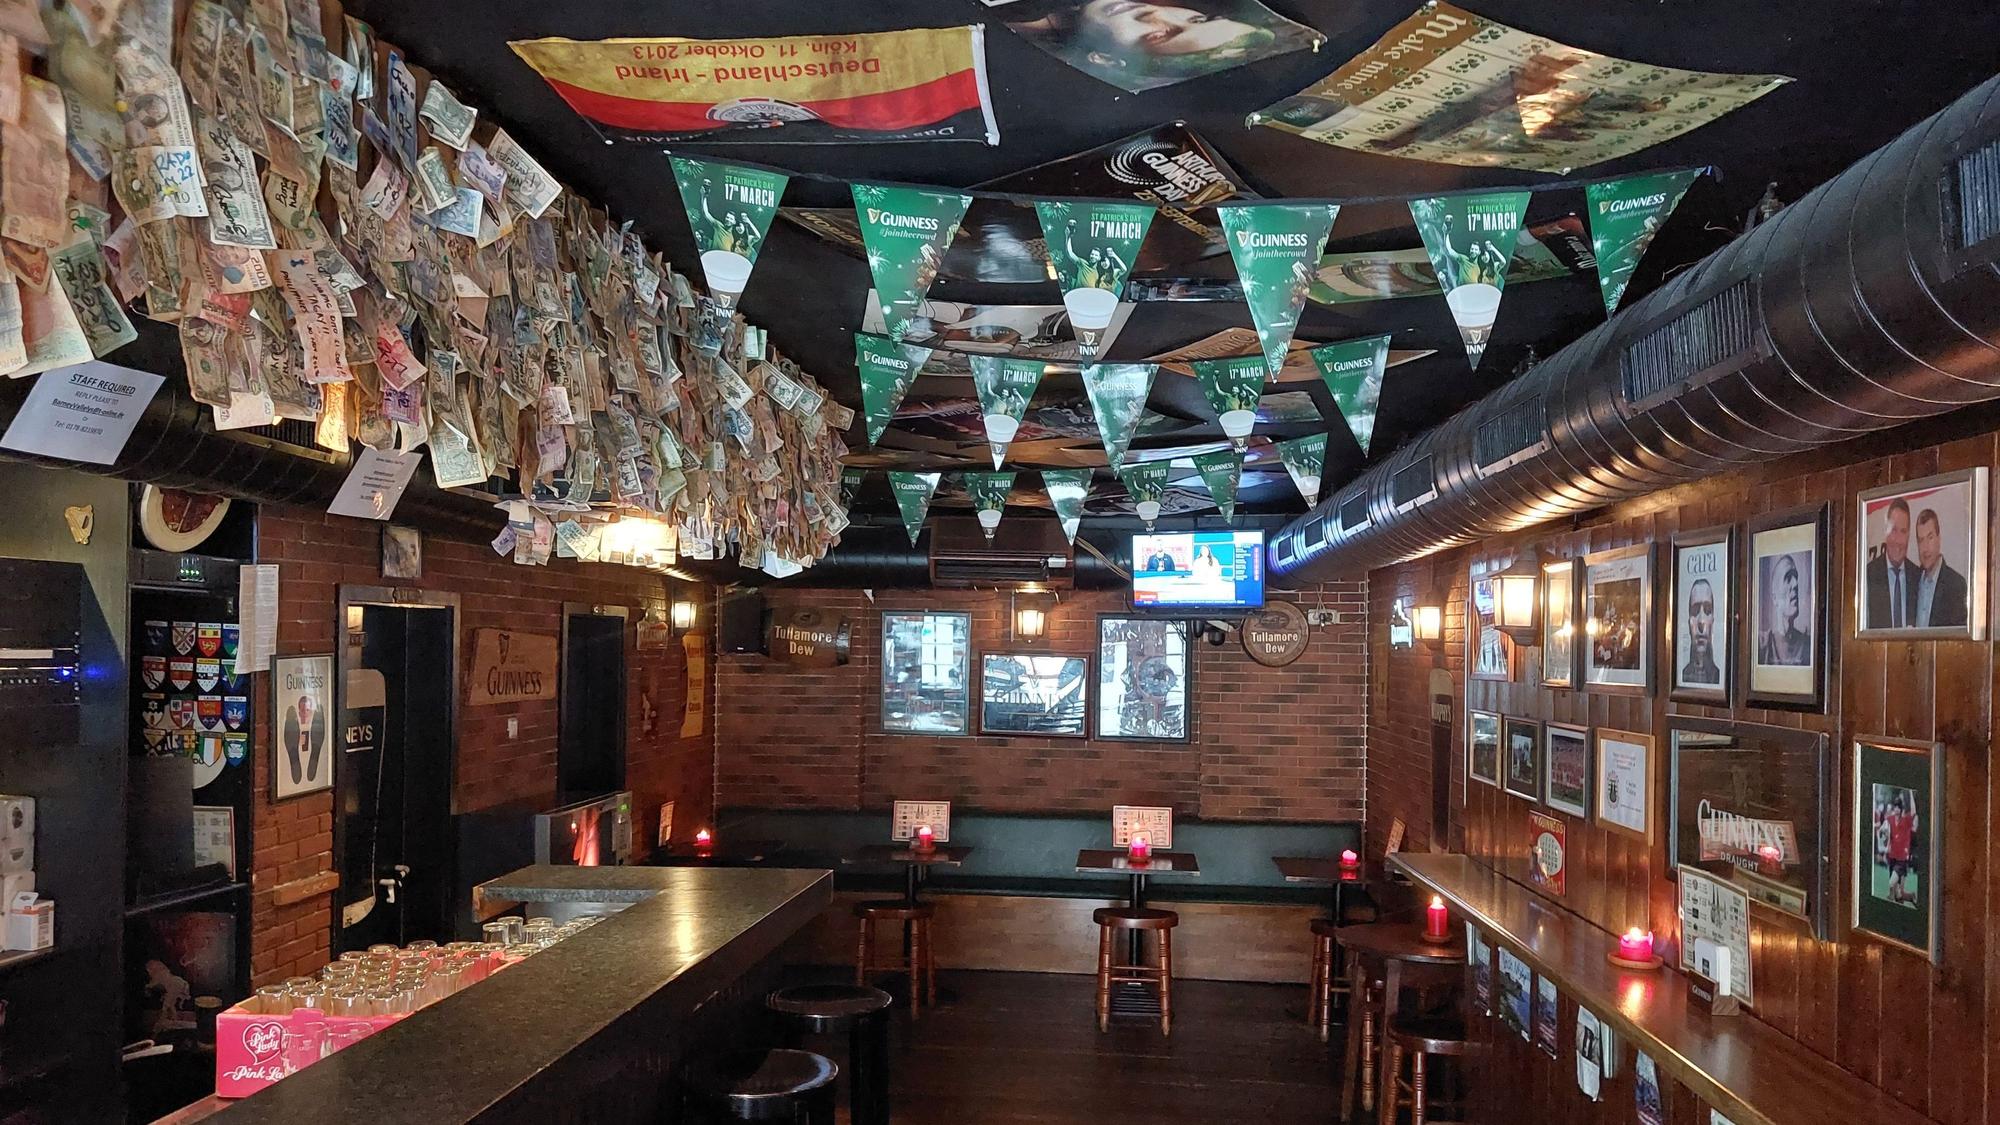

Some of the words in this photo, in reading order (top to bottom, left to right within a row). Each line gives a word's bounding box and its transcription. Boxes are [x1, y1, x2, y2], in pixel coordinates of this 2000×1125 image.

[1384, 13, 1466, 59] Make
[633, 45, 678, 60] 2013
[687, 45, 765, 59] Oktober
[772, 45, 799, 57] 11.
[806, 40, 857, 55] Köln,
[615, 65, 690, 83] Irland
[714, 58, 880, 83] Deutschland
[1337, 60, 1389, 90] mine
[1142, 152, 1207, 194] GUINNESS
[1171, 150, 1227, 183] ARTHUR
[741, 186, 775, 207] MARCH
[1153, 183, 1189, 202] DAY
[1610, 192, 1667, 213] GUINNESS
[880, 212, 939, 230] GUINNESS
[1483, 212, 1517, 231] MARCH
[1106, 222, 1141, 240] MARCH
[1250, 233, 1309, 247] GUINNESS
[251, 256, 268, 286] 2000
[871, 353, 910, 370] GUINNESS
[1334, 357, 1373, 372] GUINNESS
[1013, 370, 1036, 384] MARCH
[1240, 366, 1264, 378] MARCH
[70, 373, 97, 389] STAFF
[99, 380, 136, 395] REQUIRED
[1100, 382, 1136, 391] GUINNESS
[1208, 462, 1235, 472] GUINNESS
[901, 483, 927, 491] GUINNESS
[1687, 551, 1717, 575] cara
[774, 625, 832, 643] Tullamore
[1251, 632, 1298, 642] Tullamore
[789, 641, 814, 656] Dew
[1265, 643, 1285, 653] Dew
[286, 673, 324, 690] GUINNESS
[487, 666, 542, 696] GUINNESS
[1698, 798, 1785, 862] GUINNESS
[1720, 851, 1759, 873] DRAUGHT
[247, 1028, 277, 1048] Pink
[254, 1038, 280, 1054] Lady
[223, 1065, 267, 1081] Pink
